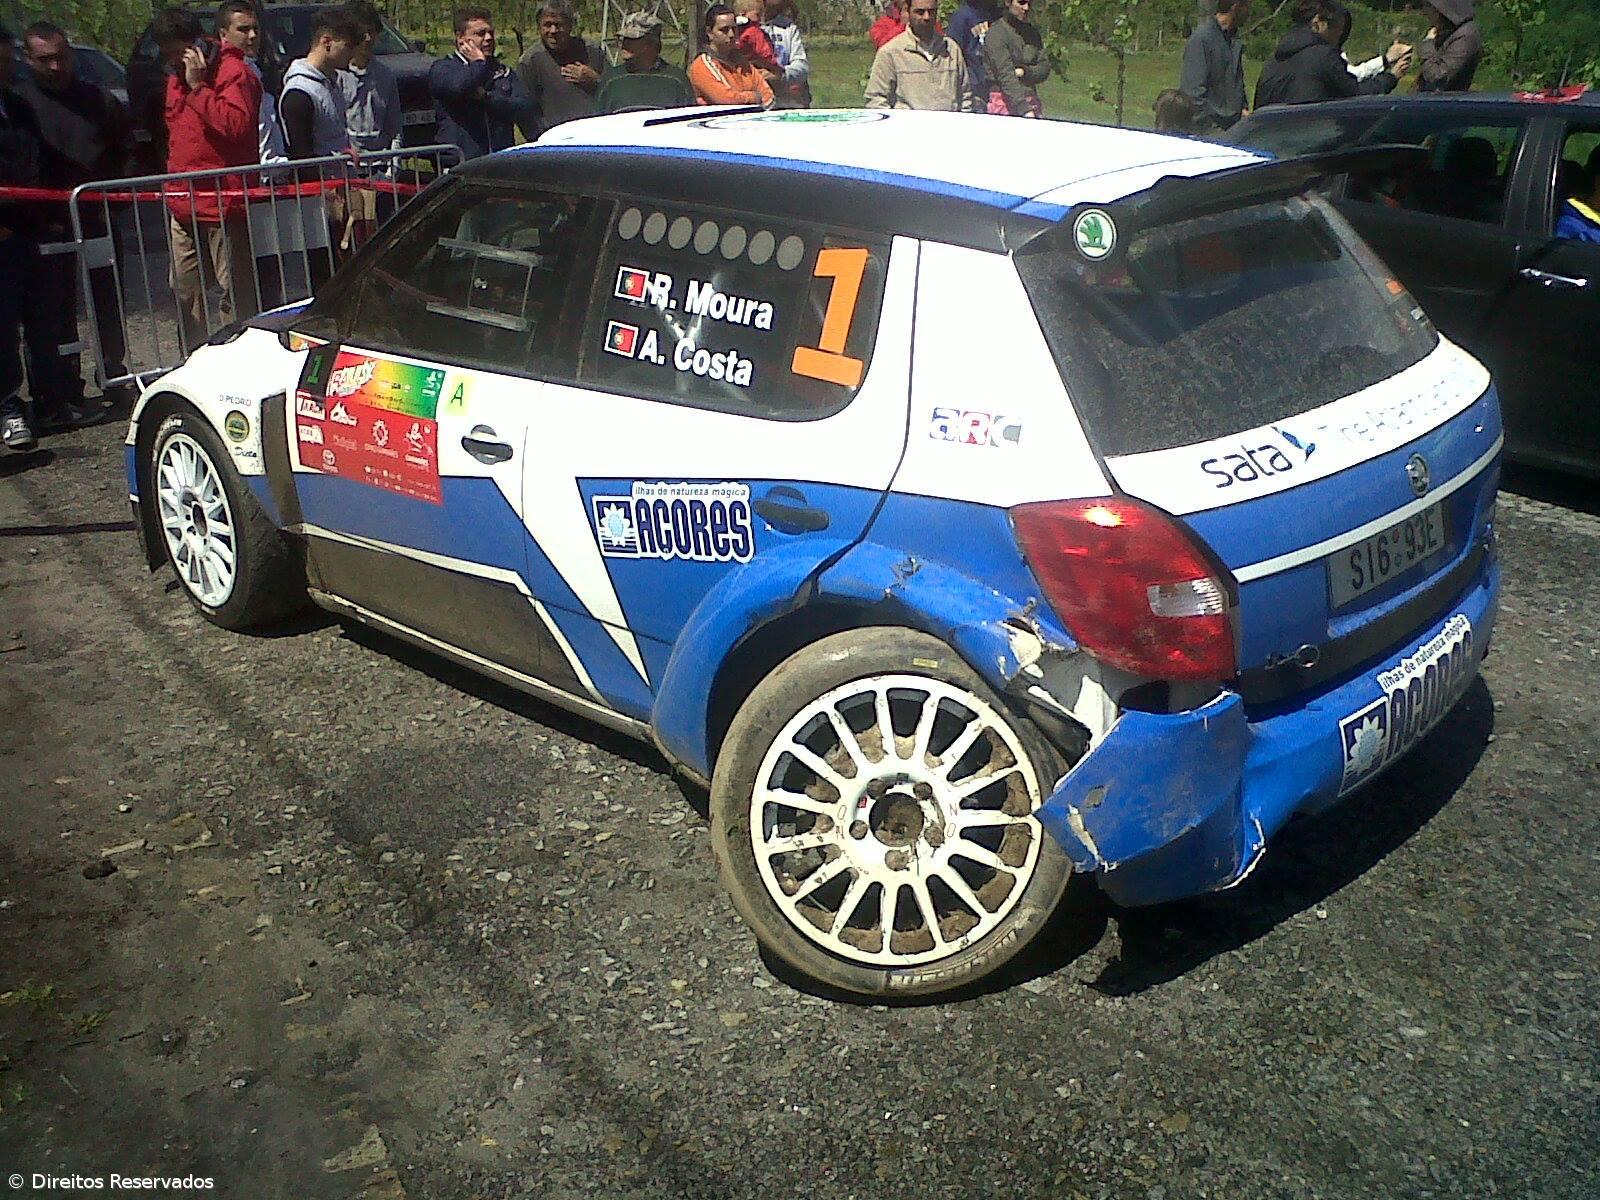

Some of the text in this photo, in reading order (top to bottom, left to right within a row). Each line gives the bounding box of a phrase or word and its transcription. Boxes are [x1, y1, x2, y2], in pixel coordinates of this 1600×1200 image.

[685, 279, 774, 330] Moura
[791, 248, 869, 386] 1
[637, 329, 753, 387] A. Costa
[450, 382, 465, 407] A
[1200, 444, 1293, 489] sata
[635, 486, 655, 496] ilhas
[657, 486, 668, 496] de
[670, 486, 709, 496] natureza
[1381, 670, 1405, 689] ilhas
